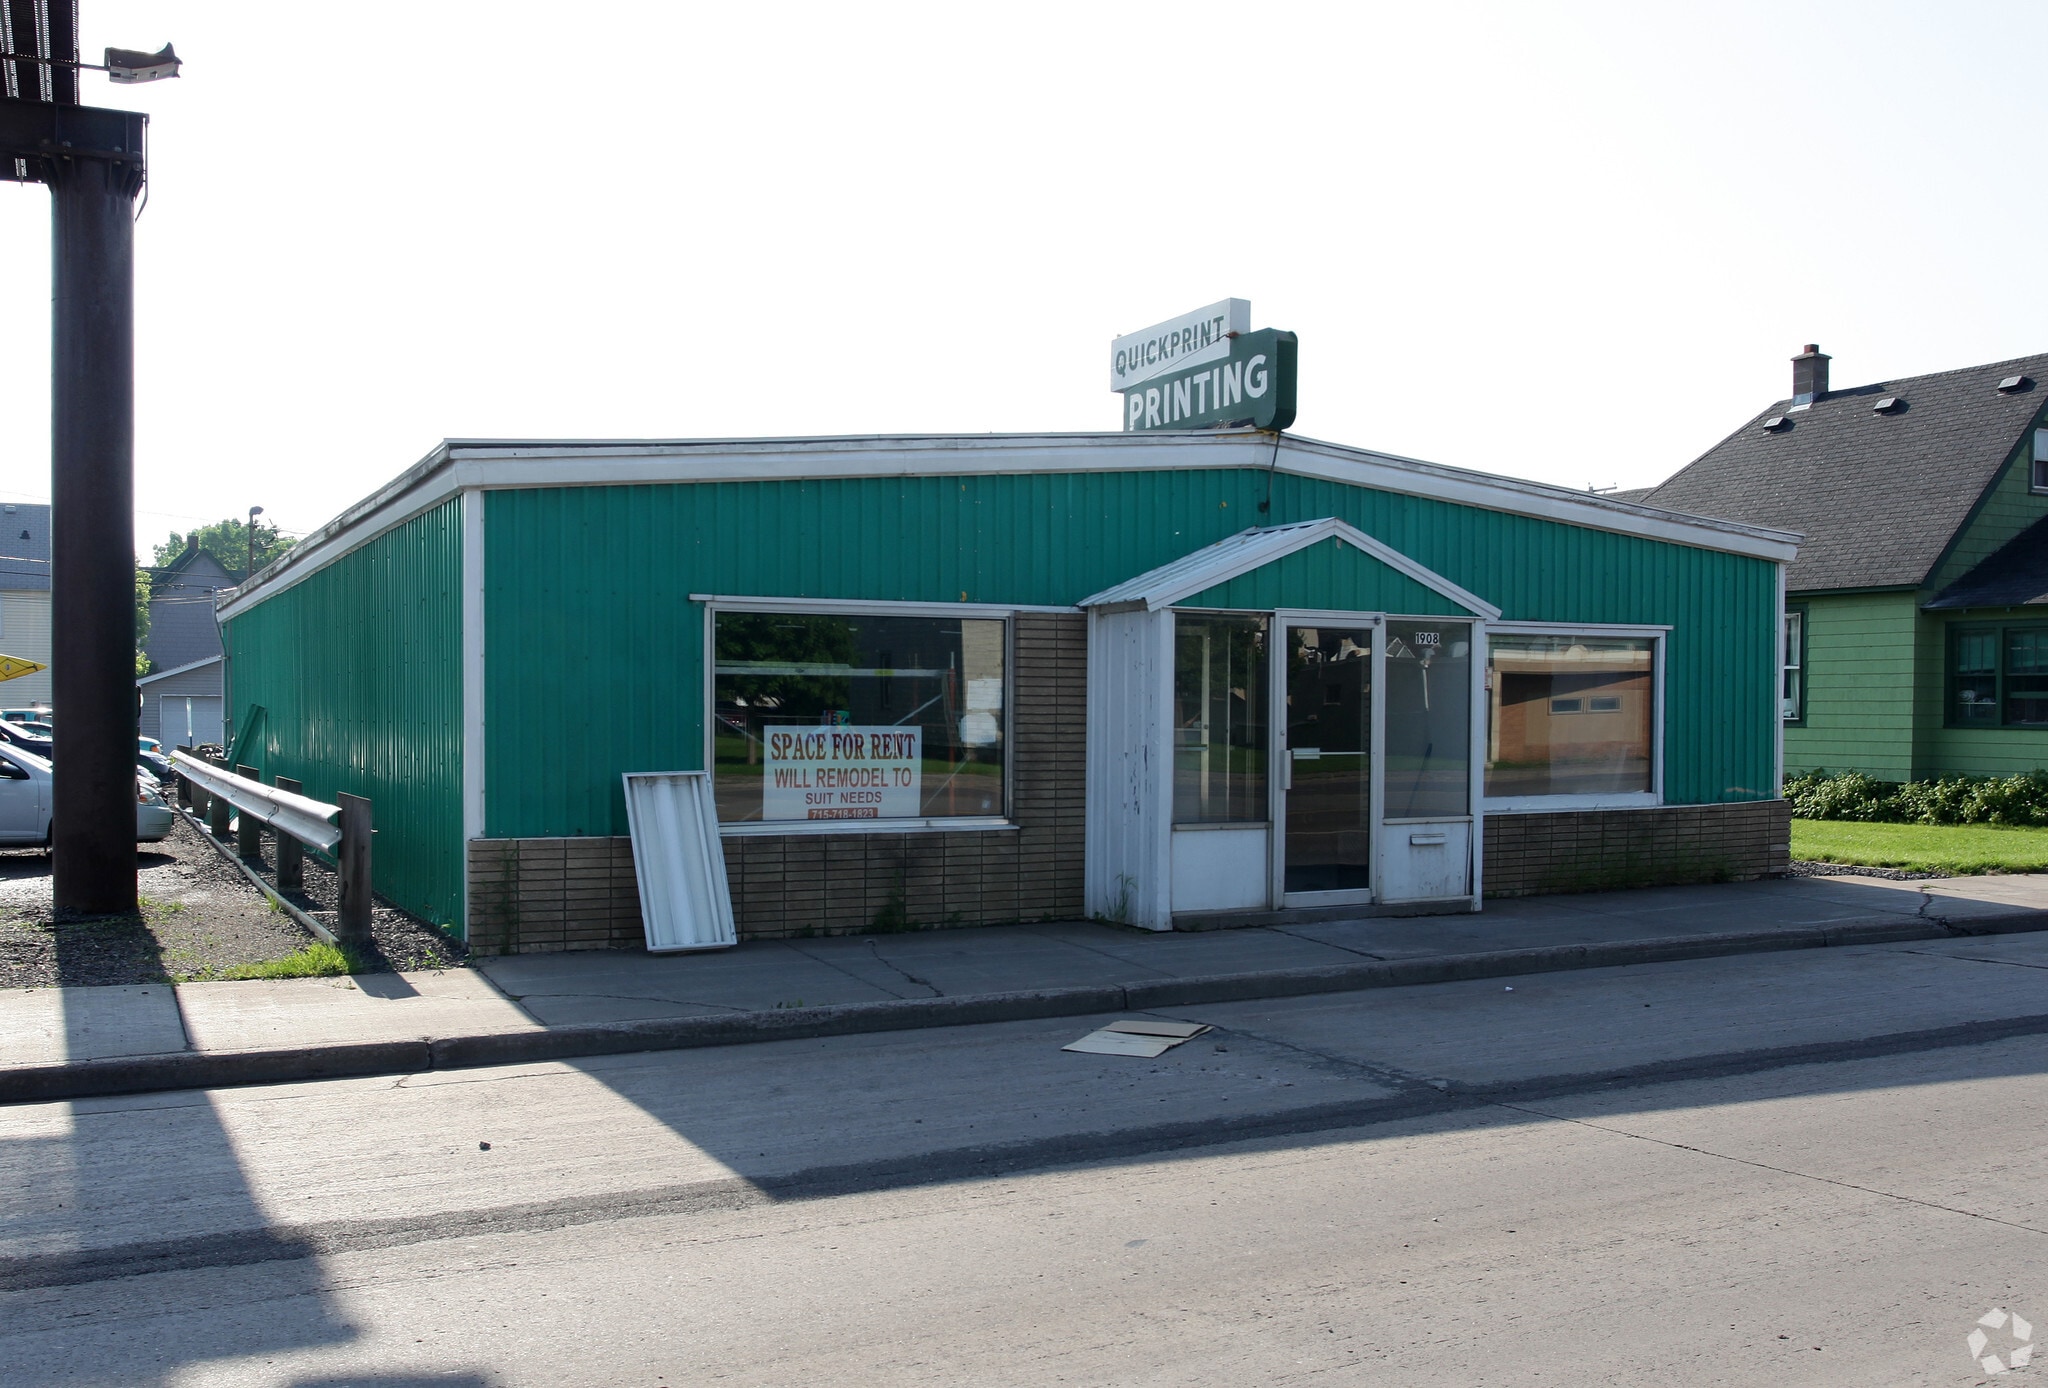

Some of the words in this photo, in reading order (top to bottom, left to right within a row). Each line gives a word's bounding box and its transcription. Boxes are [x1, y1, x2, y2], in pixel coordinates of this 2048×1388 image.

[1115, 315, 1224, 377] QUICKPRINT
[1129, 354, 1268, 431] PRINTING
[1415, 633, 1439, 644] 1908
[771, 733, 827, 760] SPACE
[832, 733, 866, 760] FOR
[870, 733, 916, 760] RENT
[774, 768, 811, 788] WILL
[816, 768, 889, 788] REMODEL
[893, 767, 912, 787] TO
[805, 792, 834, 805] SUIT
[840, 791, 882, 804] NEEDS
[812, 808, 874, 819] 715-718-1823
